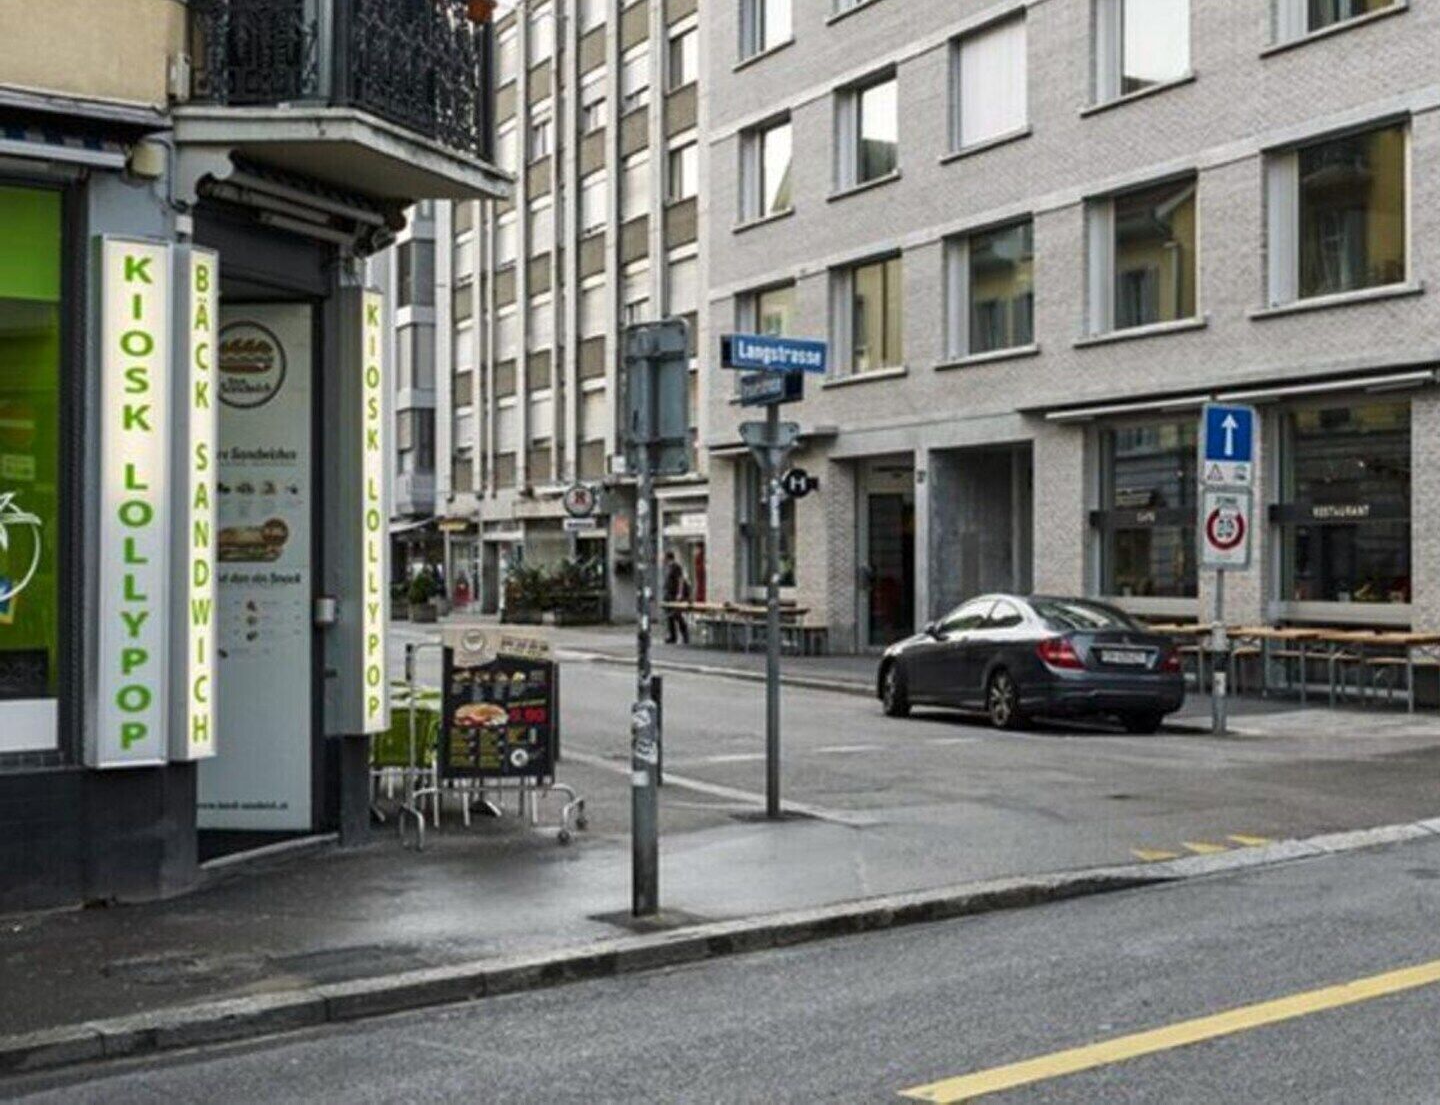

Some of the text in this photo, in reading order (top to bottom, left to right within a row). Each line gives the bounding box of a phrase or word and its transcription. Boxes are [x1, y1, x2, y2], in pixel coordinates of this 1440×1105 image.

[116, 255, 154, 750] KIOSK LOLLYPOP
[191, 264, 212, 742] BÄCK SANDWICH
[366, 304, 380, 718] KIOSK LOLLYPOP
[738, 339, 822, 367] Langstrasse
[790, 476, 806, 491] H
